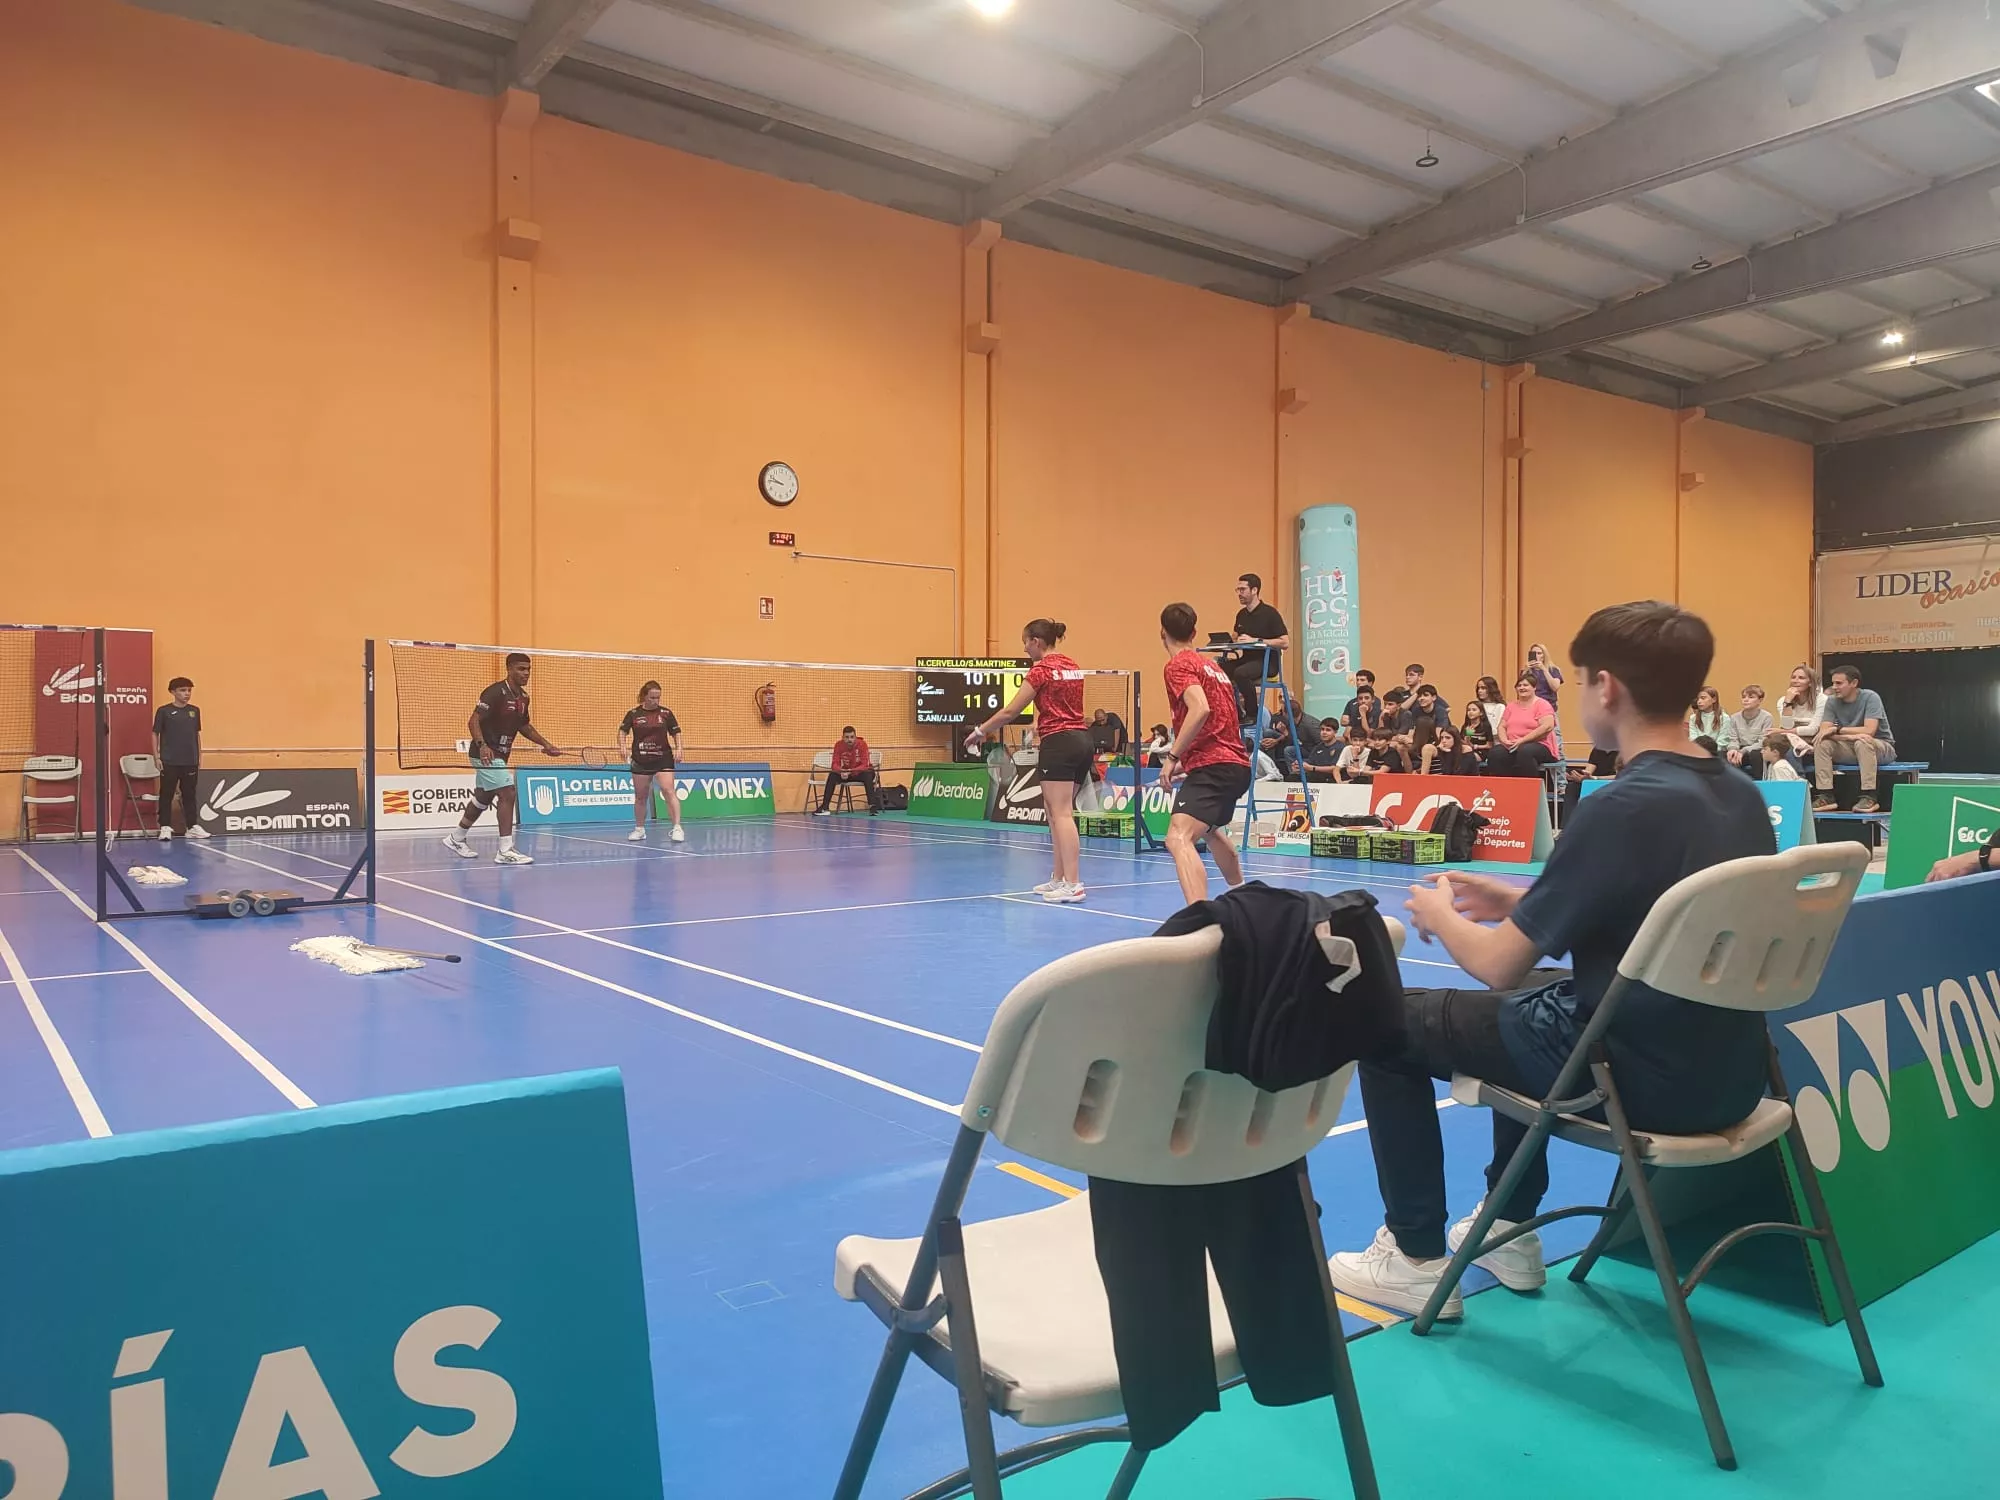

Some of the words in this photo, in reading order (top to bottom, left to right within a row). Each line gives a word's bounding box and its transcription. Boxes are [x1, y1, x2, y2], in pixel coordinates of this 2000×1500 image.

[1856, 570, 1952, 599] LIDER
[60, 693, 147, 704] BADINTON
[917, 698, 923, 706] 0
[963, 694, 981, 708] 11
[987, 694, 998, 708] 6
[412, 788, 477, 801] GOBIERN
[700, 778, 767, 800] YONEX
[934, 781, 984, 800] Iberdrola
[305, 802, 350, 811] ESPAÑA
[1141, 786, 1177, 814] YON
[413, 802, 433, 814] DE
[1007, 806, 1047, 822] BADMIN
[225, 813, 351, 831] BADMINTON
[1478, 828, 1511, 837] uperior
[1484, 837, 1526, 849] Deportes
